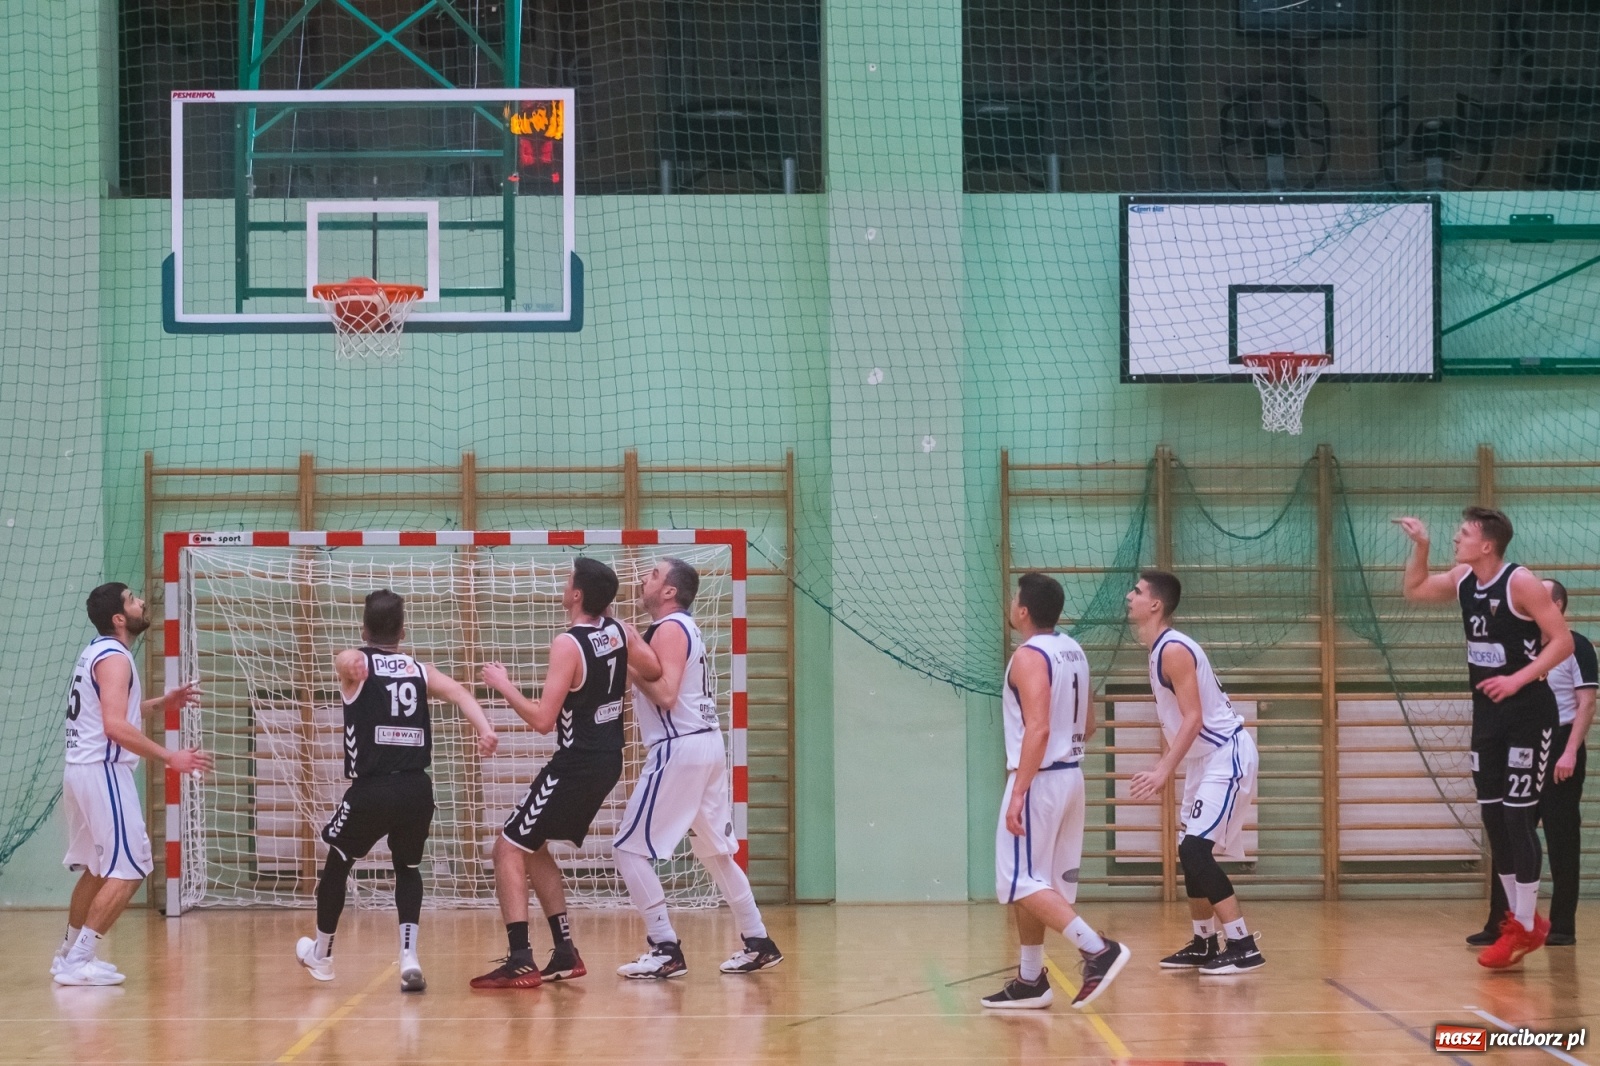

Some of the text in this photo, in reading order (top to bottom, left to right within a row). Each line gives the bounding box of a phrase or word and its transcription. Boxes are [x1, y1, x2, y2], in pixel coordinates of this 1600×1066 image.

[218, 535, 242, 543] sport
[374, 656, 407, 674] piga
[606, 656, 617, 695] 7
[385, 681, 418, 717] 19
[1072, 672, 1080, 724] 1
[1508, 773, 1533, 798] 22
